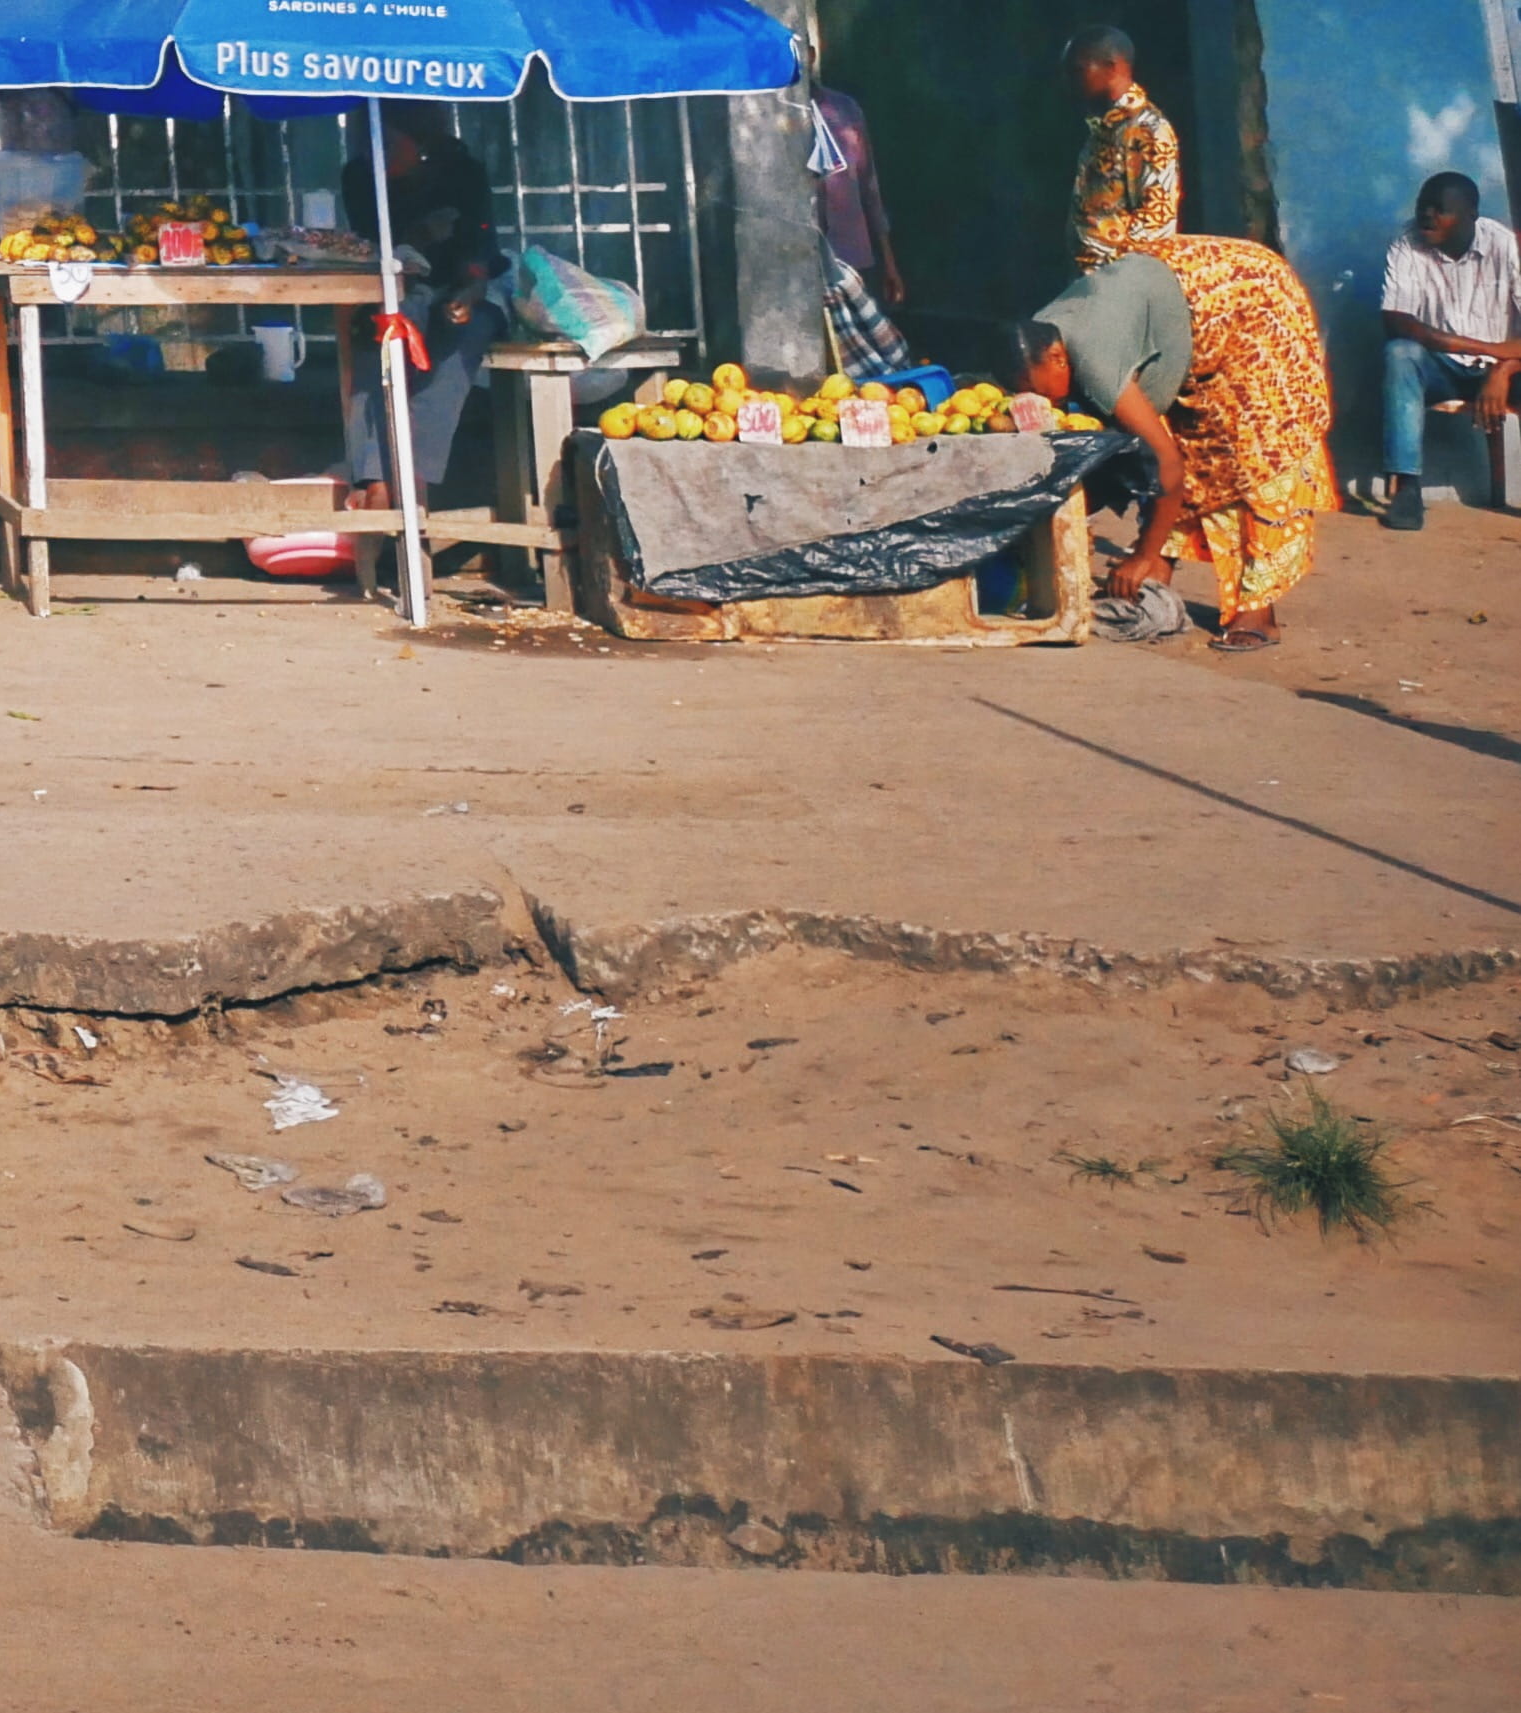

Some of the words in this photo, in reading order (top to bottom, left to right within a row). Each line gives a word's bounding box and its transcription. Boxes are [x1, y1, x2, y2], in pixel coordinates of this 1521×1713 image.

[269, 0, 356, 13] SARDINES
[364, 3, 377, 14] A
[384, 4, 447, 17] L'HUILE
[217, 42, 290, 78] Plus
[304, 52, 486, 89] savoureux
